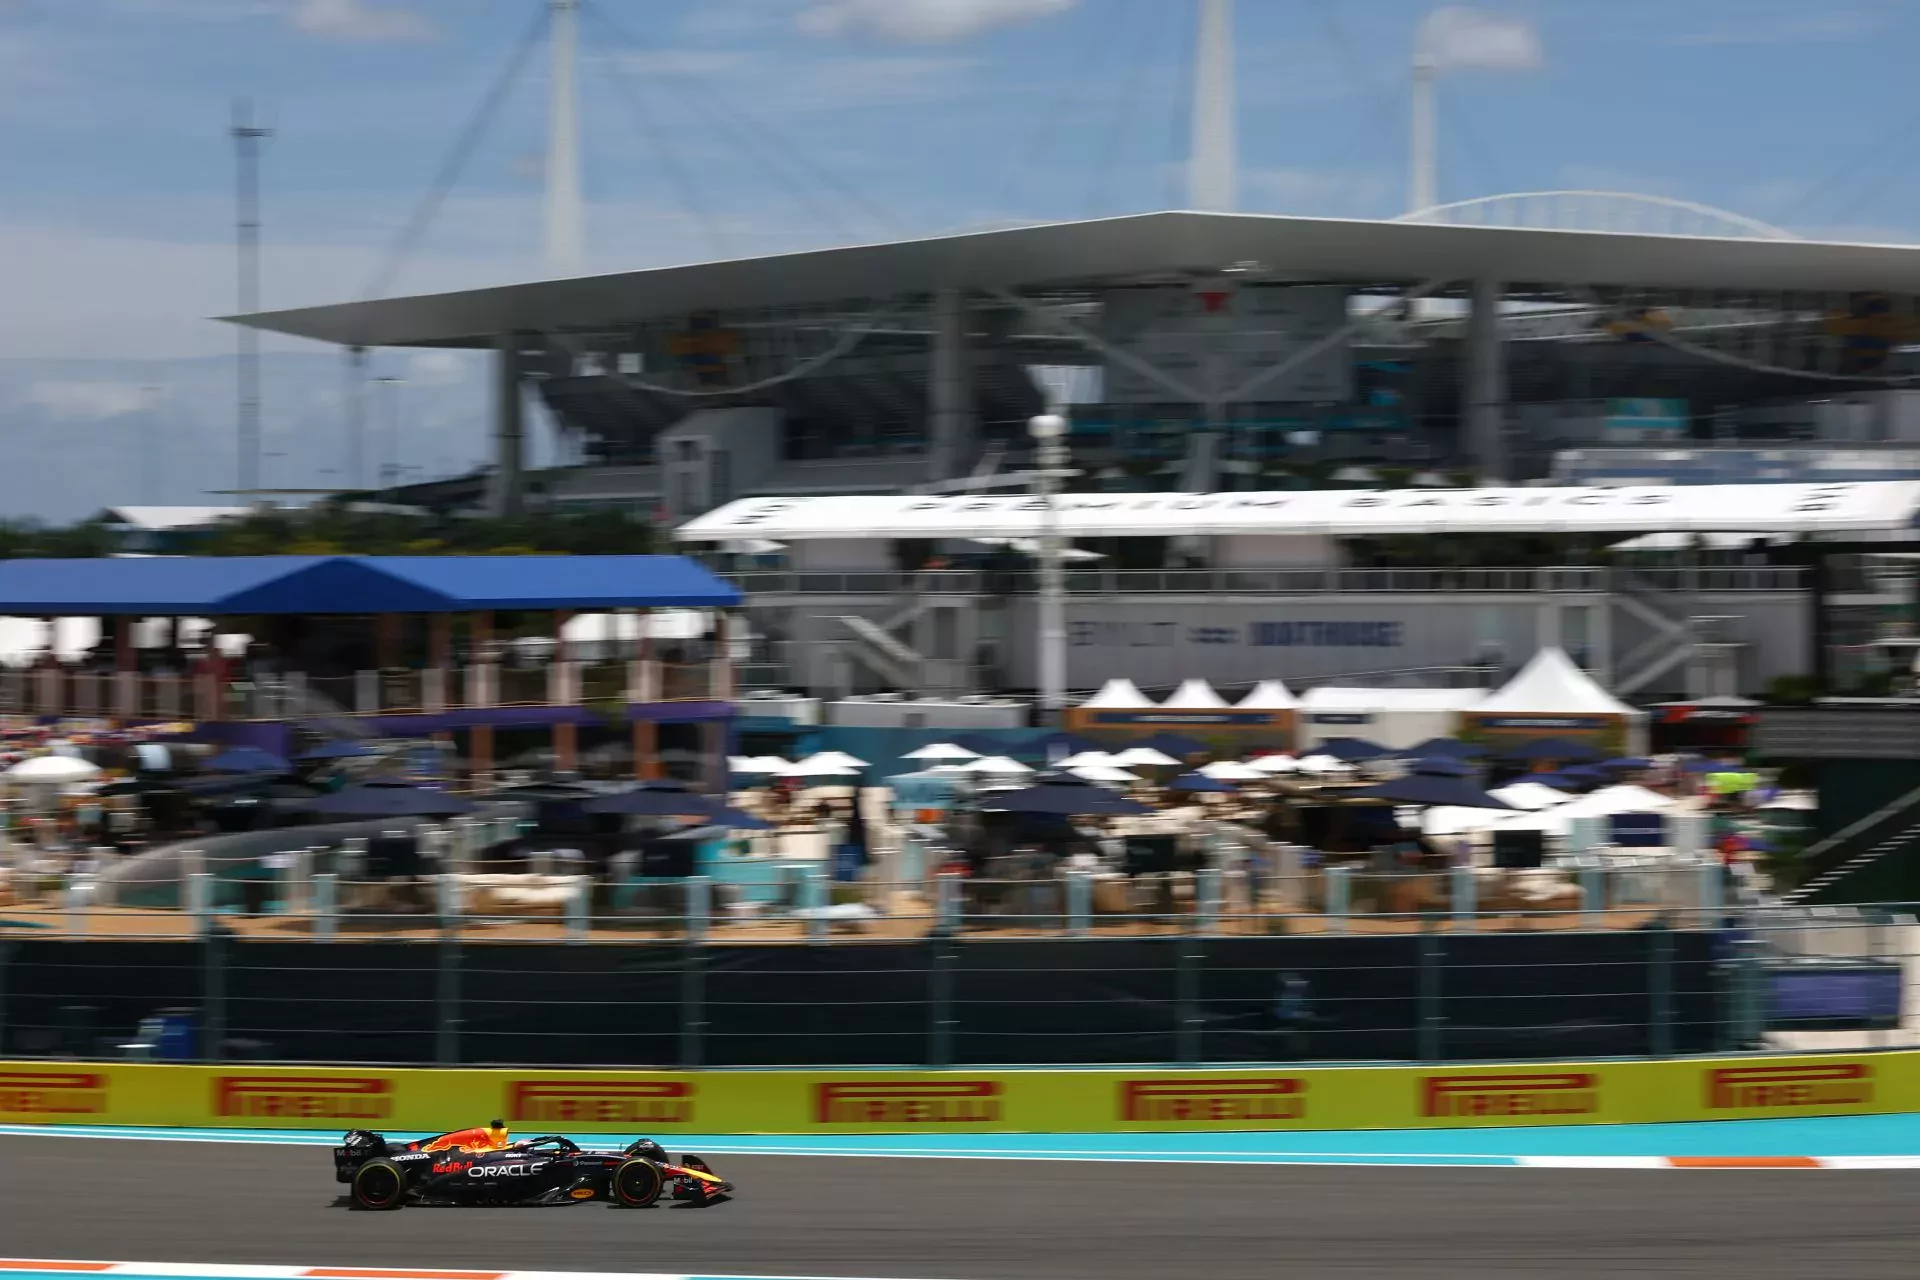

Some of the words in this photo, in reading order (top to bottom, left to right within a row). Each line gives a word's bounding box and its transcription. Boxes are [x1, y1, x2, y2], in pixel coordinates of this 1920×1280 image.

[214, 1076, 396, 1119] PIRELLI
[506, 1081, 695, 1121] PIRELLI
[811, 1081, 1004, 1123] PIRELLI
[1118, 1078, 1307, 1121] PIRELLI
[1420, 1073, 1602, 1117] PIRELLI
[1705, 1065, 1876, 1108] PIRELLI
[467, 1162, 544, 1178] ORACLE
